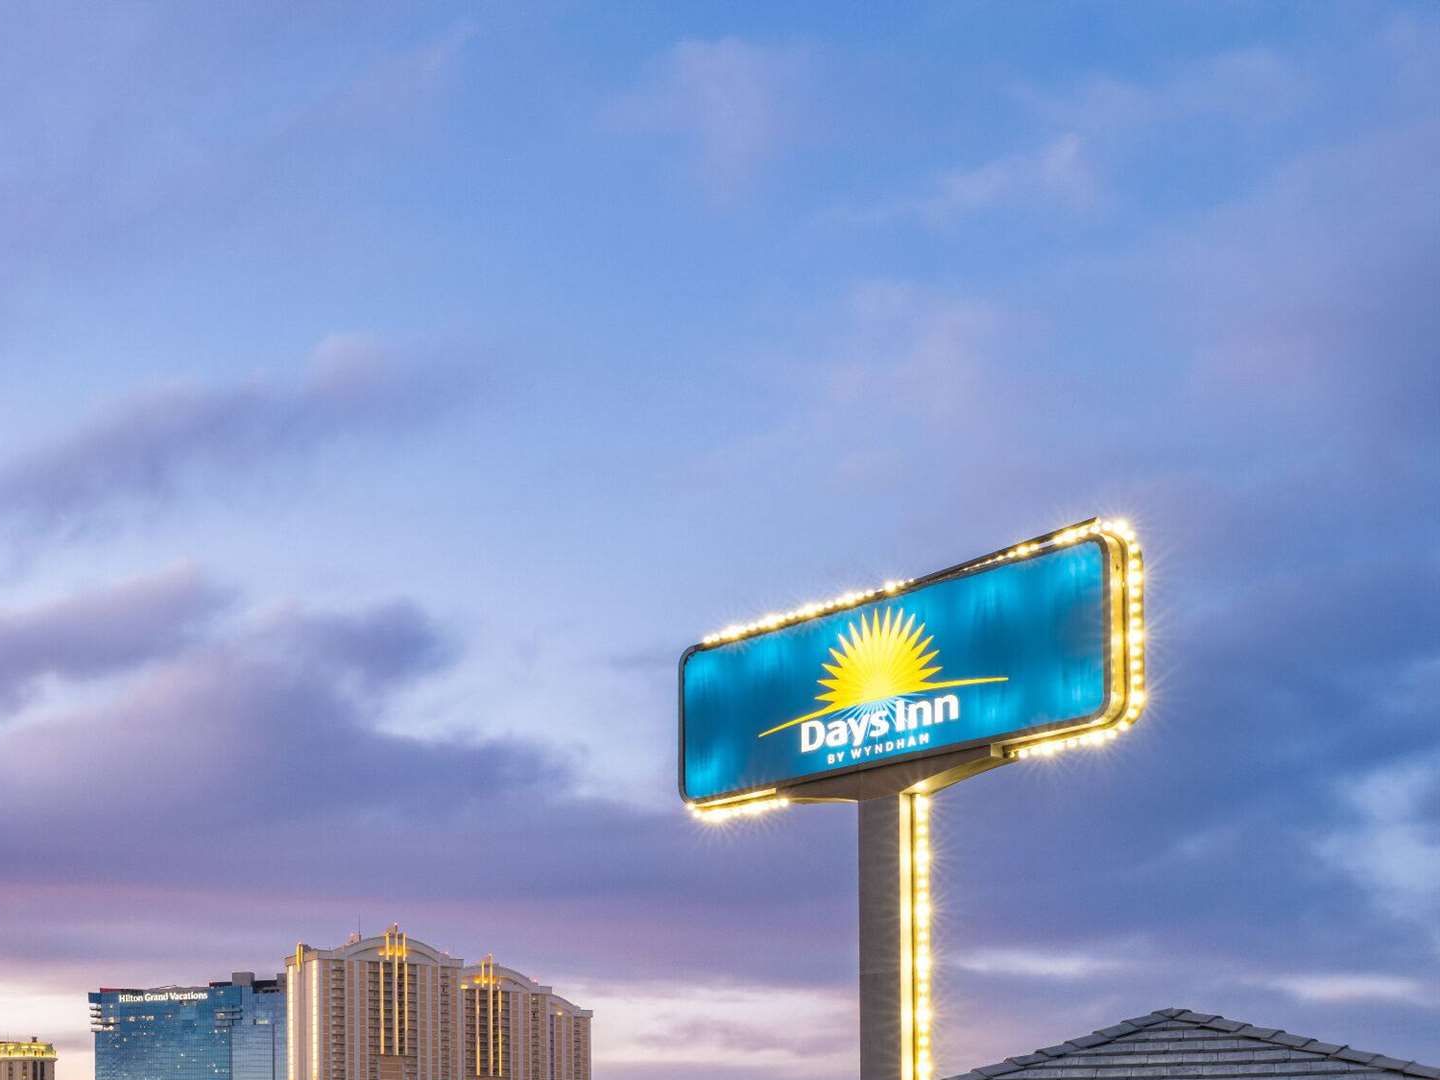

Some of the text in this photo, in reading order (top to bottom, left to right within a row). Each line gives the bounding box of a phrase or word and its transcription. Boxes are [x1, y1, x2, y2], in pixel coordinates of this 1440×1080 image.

[800, 694, 959, 752] Days Inn
[827, 732, 930, 765] BY WYNDHAM
[119, 991, 208, 1003] Hilton Grand Vacations
